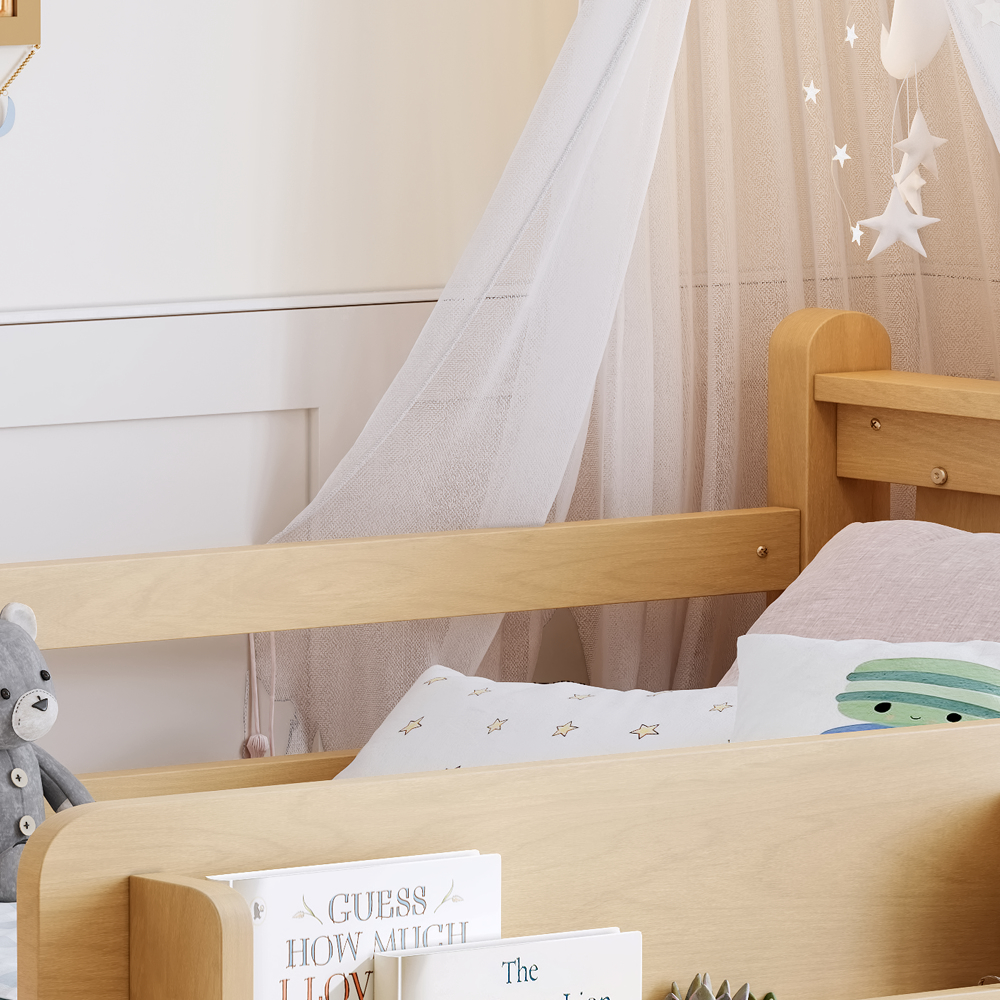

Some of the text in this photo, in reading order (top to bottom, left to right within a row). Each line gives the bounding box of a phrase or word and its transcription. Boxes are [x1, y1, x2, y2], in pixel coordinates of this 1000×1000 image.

[328, 885, 428, 924] GUESS
[286, 921, 469, 969] HOW MUCH
[502, 957, 539, 985] The
